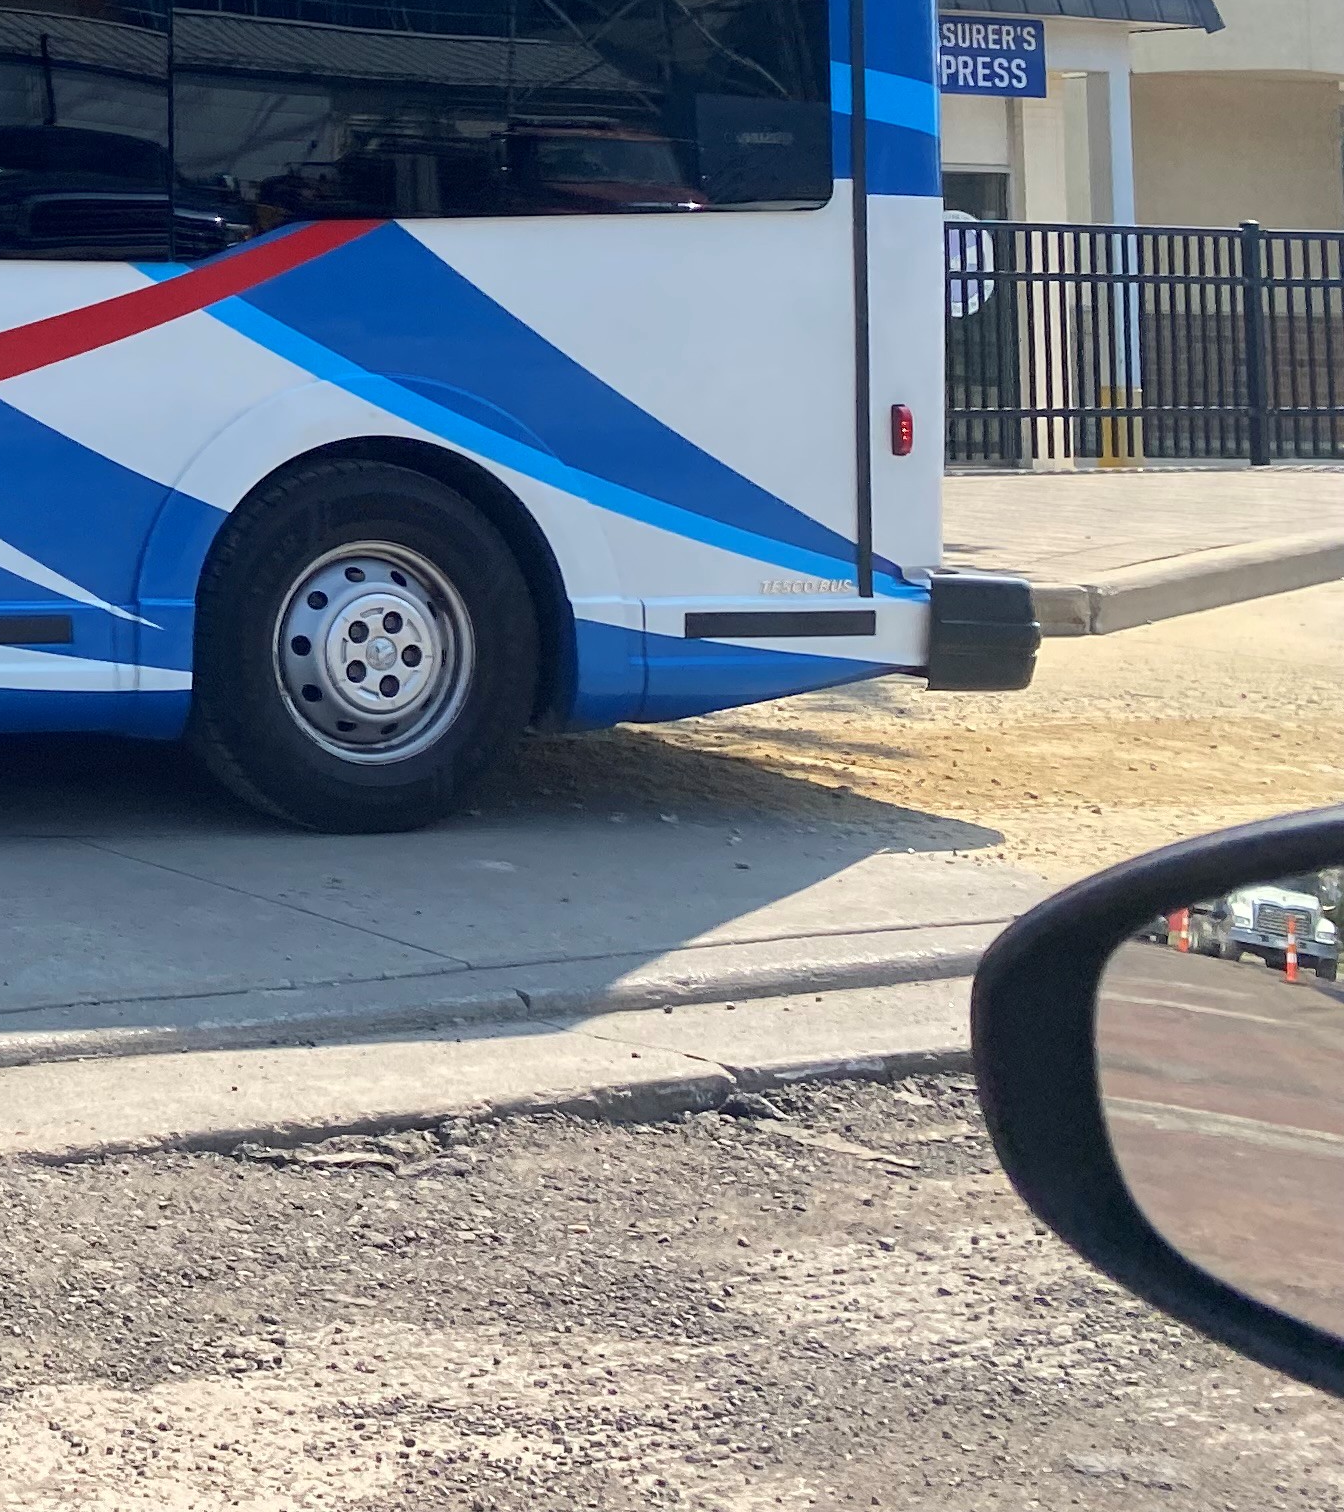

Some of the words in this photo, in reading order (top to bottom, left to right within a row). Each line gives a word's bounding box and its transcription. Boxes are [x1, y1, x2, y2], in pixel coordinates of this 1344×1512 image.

[939, 22, 1037, 51] SURER'S
[941, 54, 1028, 89] PRESS
[760, 580, 815, 594] TESCO
[818, 579, 853, 593] BUS
